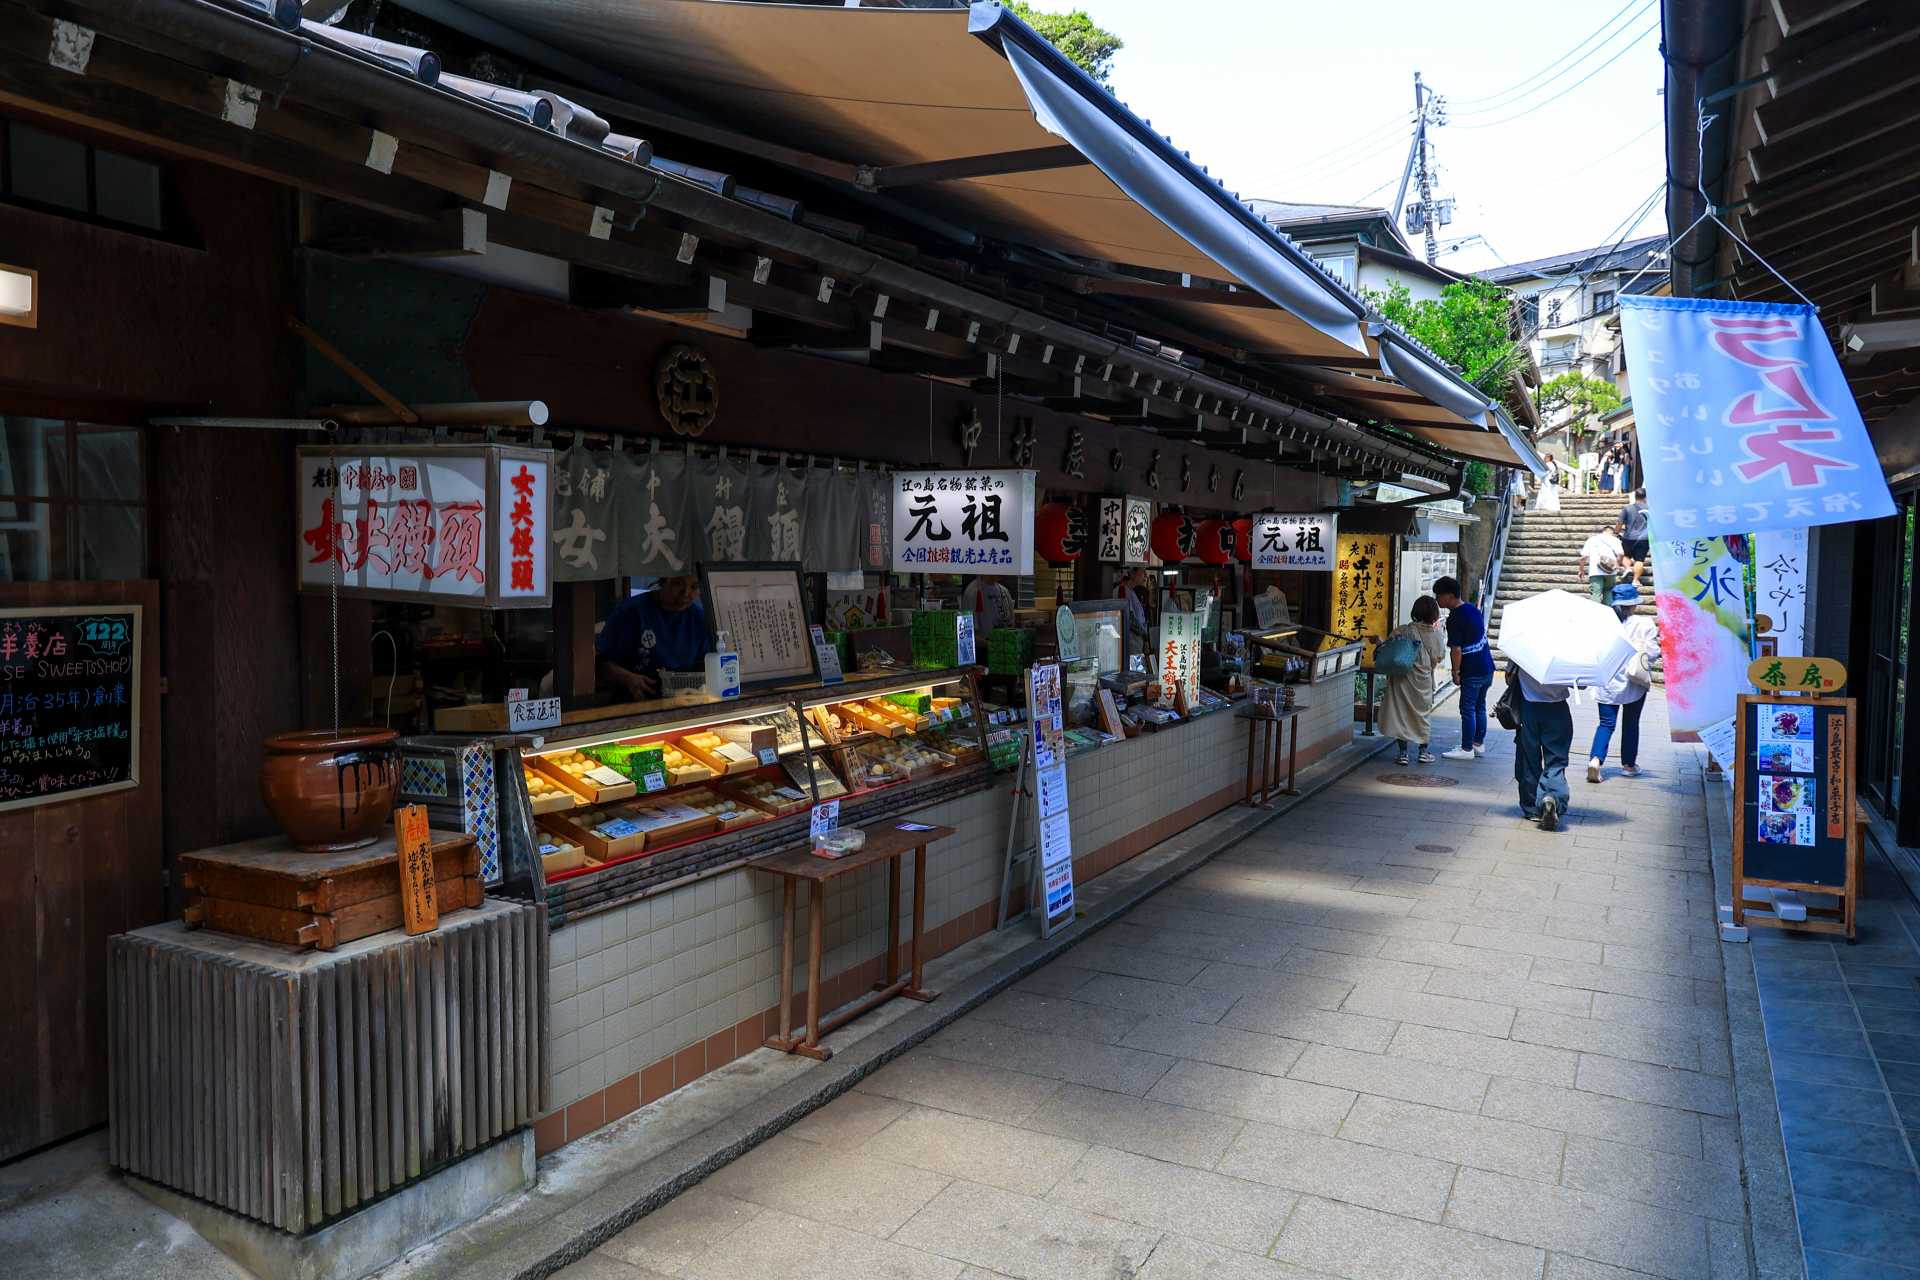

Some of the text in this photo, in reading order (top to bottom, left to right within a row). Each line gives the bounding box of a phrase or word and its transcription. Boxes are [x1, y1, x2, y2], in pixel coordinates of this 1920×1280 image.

[902, 476, 1005, 492] 江の島名物銘菓の
[509, 464, 536, 592] 女夫饅頭
[904, 494, 1009, 542] 元祖
[1099, 502, 1120, 558] 中村屋
[303, 498, 486, 583] 女夫饅頭
[1260, 526, 1325, 552] 元祖
[1348, 541, 1377, 558] 老舗
[1349, 556, 1371, 642] 中村屋の羊
[85, 621, 125, 641] 122
[1760, 661, 1823, 689] 茶房
[513, 699, 560, 722] 食器返却
